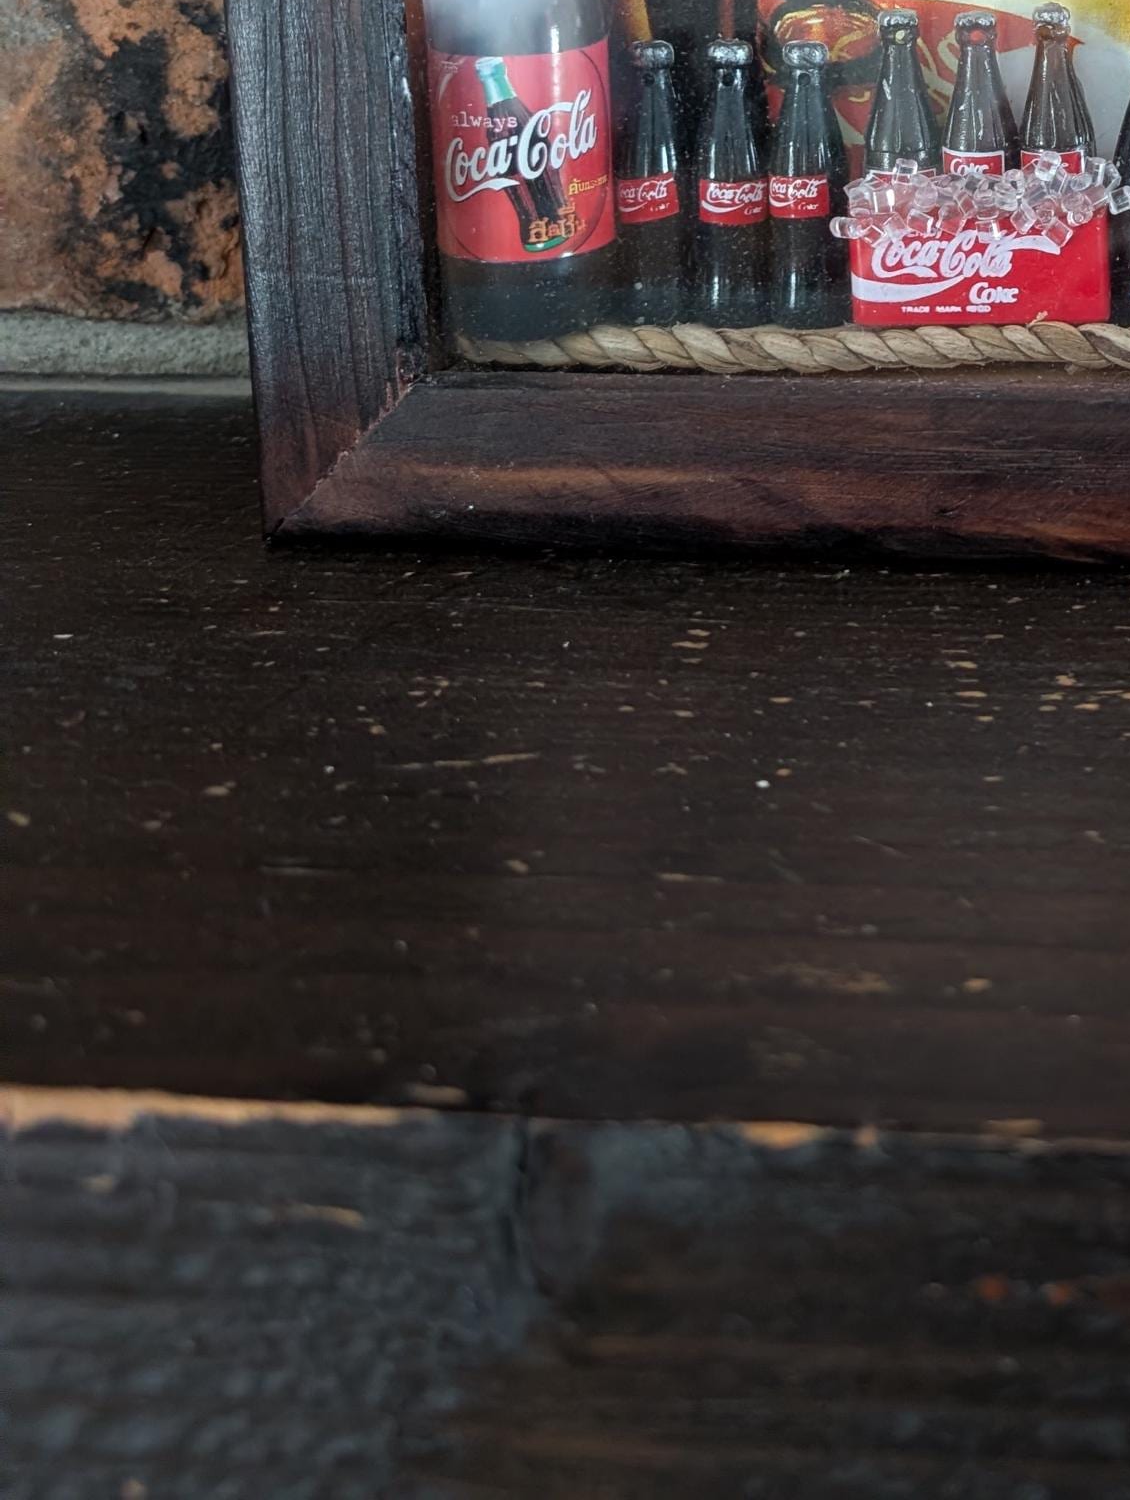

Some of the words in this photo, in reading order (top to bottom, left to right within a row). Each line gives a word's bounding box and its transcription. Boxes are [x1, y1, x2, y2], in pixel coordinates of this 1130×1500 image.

[445, 88, 598, 203] Coca-Cola
[450, 111, 519, 132] always
[872, 229, 1018, 279] Coca-Cola
